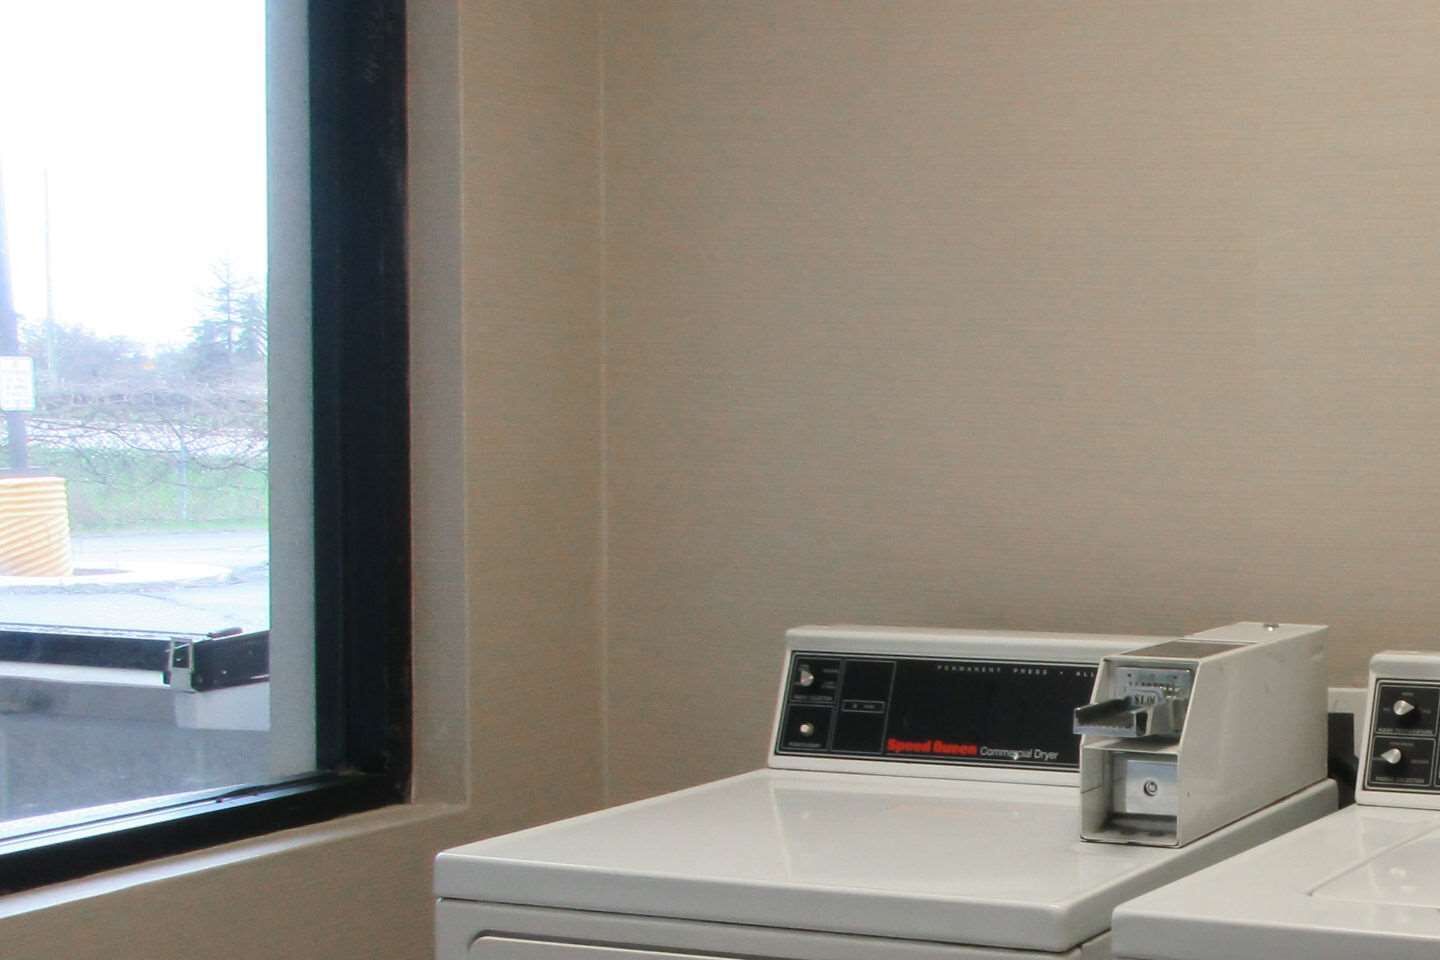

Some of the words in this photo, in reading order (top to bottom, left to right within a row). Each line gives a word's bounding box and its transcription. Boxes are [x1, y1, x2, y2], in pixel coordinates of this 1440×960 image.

[886, 736, 931, 754] Speed
[932, 738, 978, 757] Queen
[1034, 747, 1059, 761] Dryer
